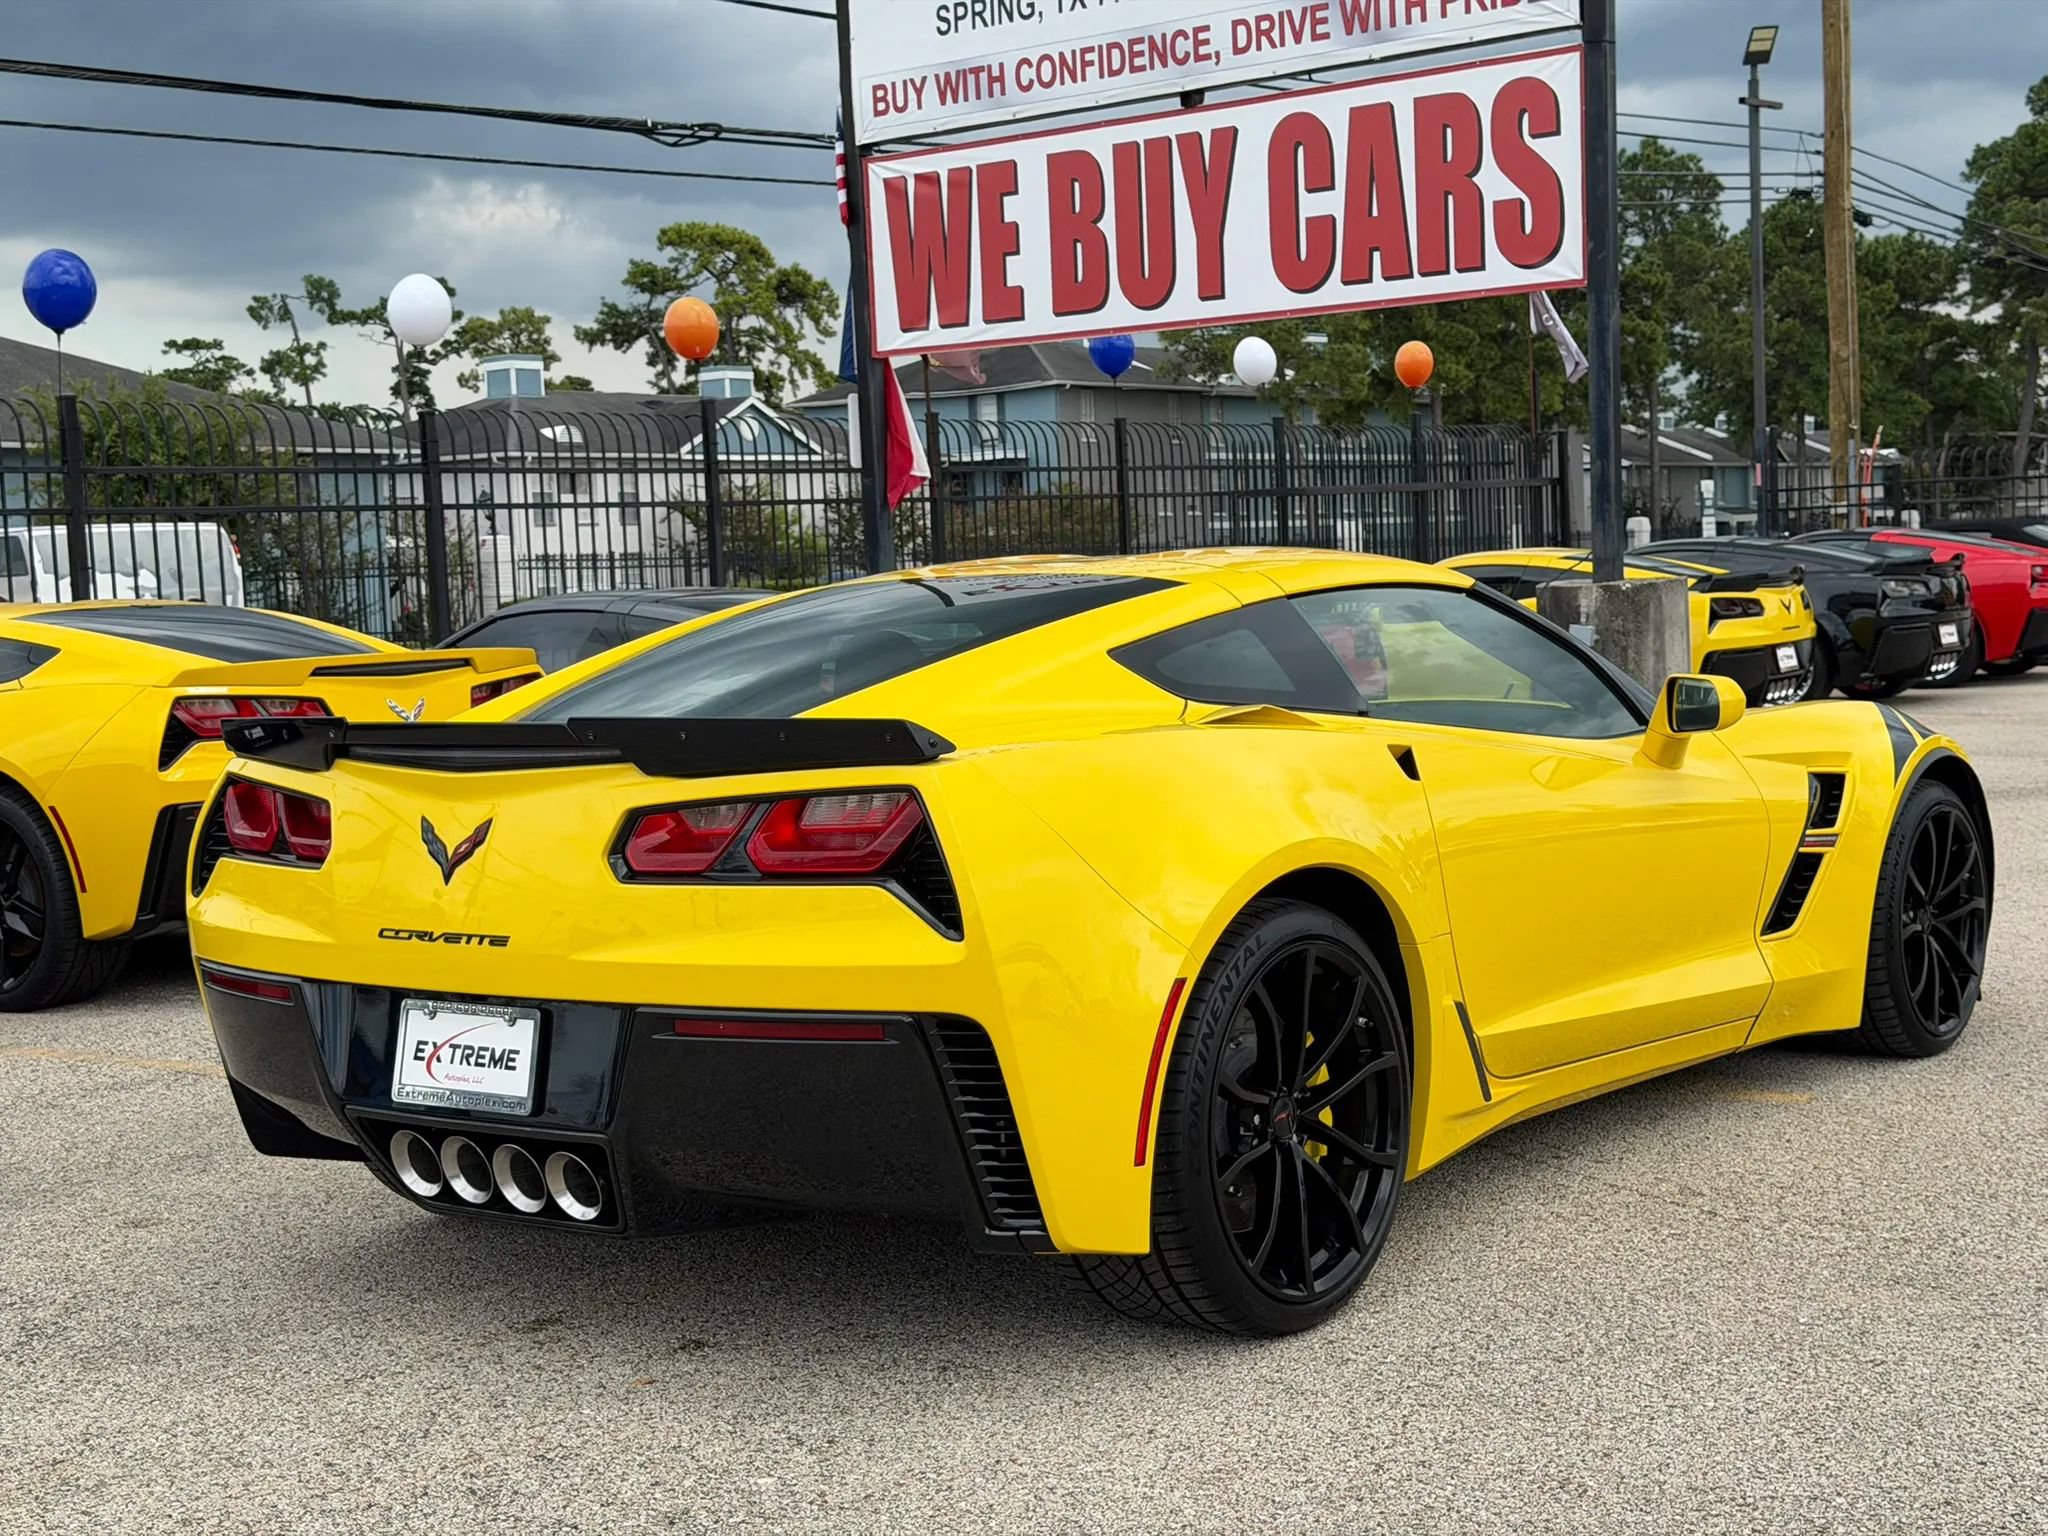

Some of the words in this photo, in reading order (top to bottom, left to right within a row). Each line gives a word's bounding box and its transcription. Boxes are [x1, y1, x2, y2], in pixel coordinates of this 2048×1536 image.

[936, 0, 1043, 36] SPRING,
[871, 75, 928, 118] BUY
[934, 62, 1006, 107] WITH
[1015, 24, 1220, 94] CONFIDENCE,
[1231, 5, 1331, 55] DRIVE
[1340, 0, 1428, 36] WITH
[883, 159, 1025, 333] WE
[1046, 125, 1239, 318] BUY
[1267, 75, 1566, 295] CARS
[378, 928, 511, 948] CORVETTE
[413, 1039, 521, 1072] EXTREME
[396, 1086, 527, 1111] ExtremeAutoplex.com
